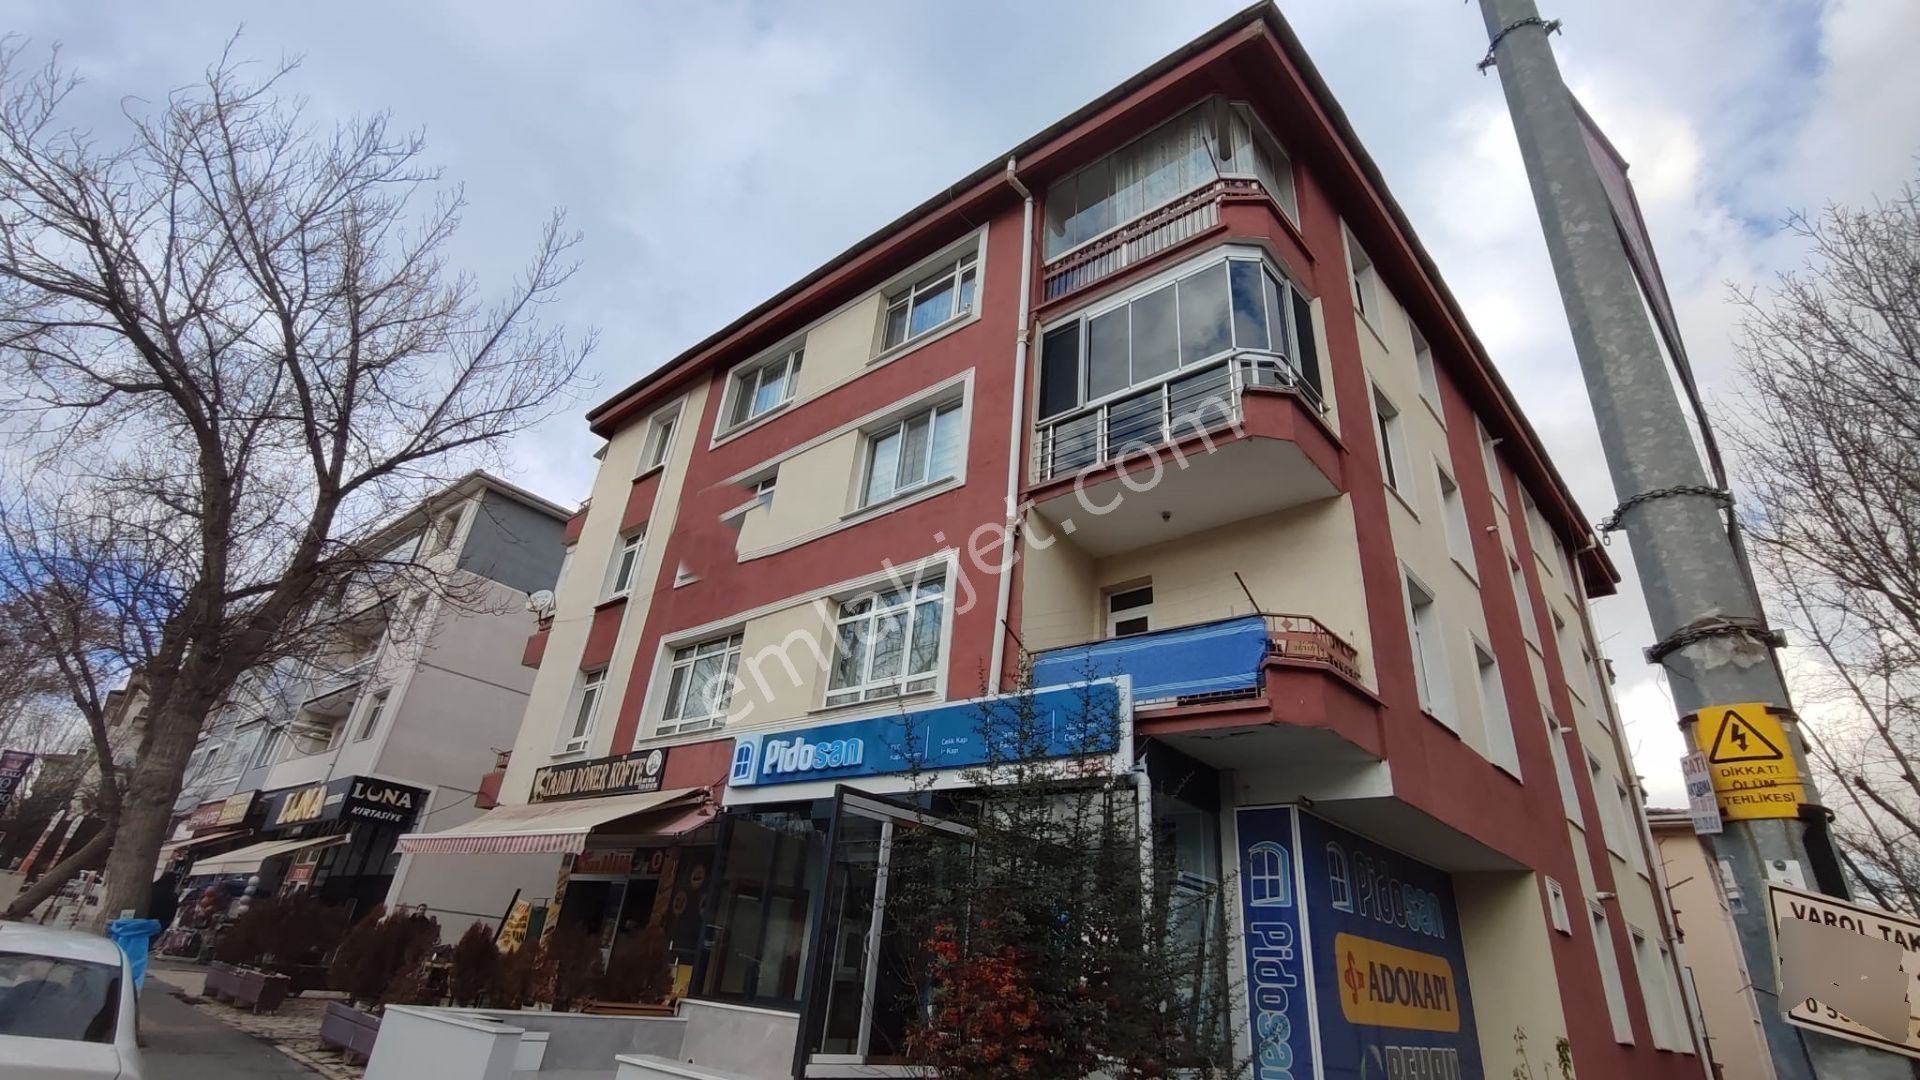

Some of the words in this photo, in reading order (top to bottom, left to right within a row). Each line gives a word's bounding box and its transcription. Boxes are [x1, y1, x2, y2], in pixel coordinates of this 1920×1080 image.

[573, 762, 609, 792] DÖNER
[608, 755, 647, 789] KÖFTE
[762, 737, 864, 774] Pidosan
[276, 785, 327, 824] LUNA
[351, 805, 403, 822] KIRTASİYE
[352, 783, 412, 808] LUNA
[1725, 792, 1796, 805] TEHLİKESİ
[1354, 850, 1445, 939] Pidosan
[1369, 961, 1450, 1012] ADOKAPI
